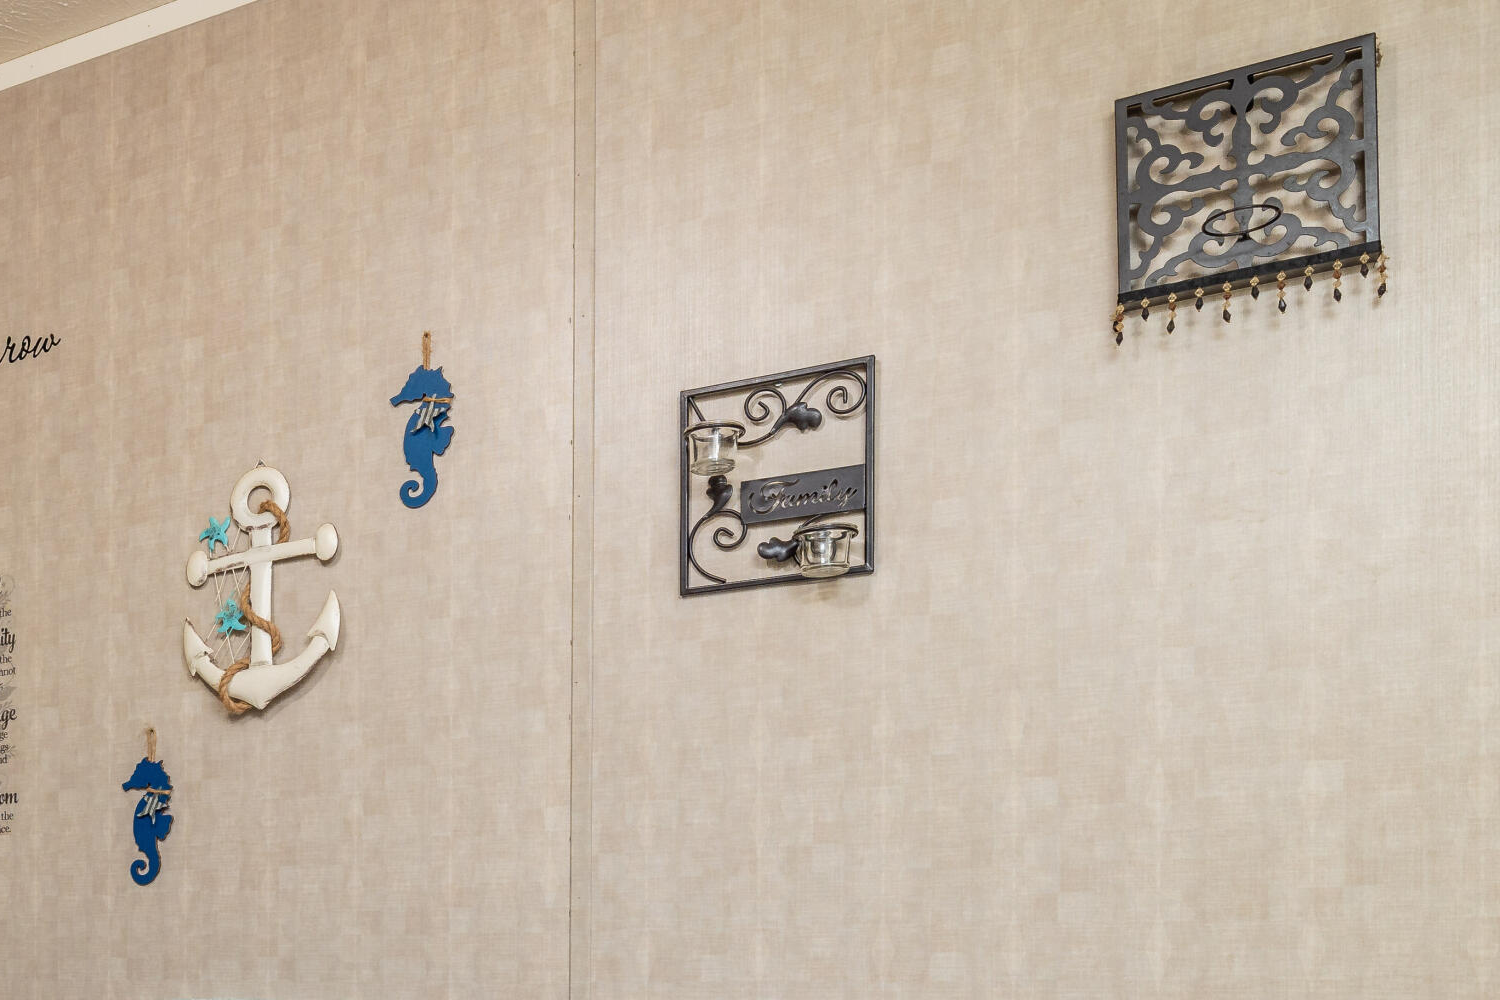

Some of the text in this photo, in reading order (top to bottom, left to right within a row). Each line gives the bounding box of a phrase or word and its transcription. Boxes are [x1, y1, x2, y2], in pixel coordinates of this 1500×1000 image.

[748, 478, 857, 515] Family
[0, 655, 12, 664] the
[1, 811, 14, 821] the
